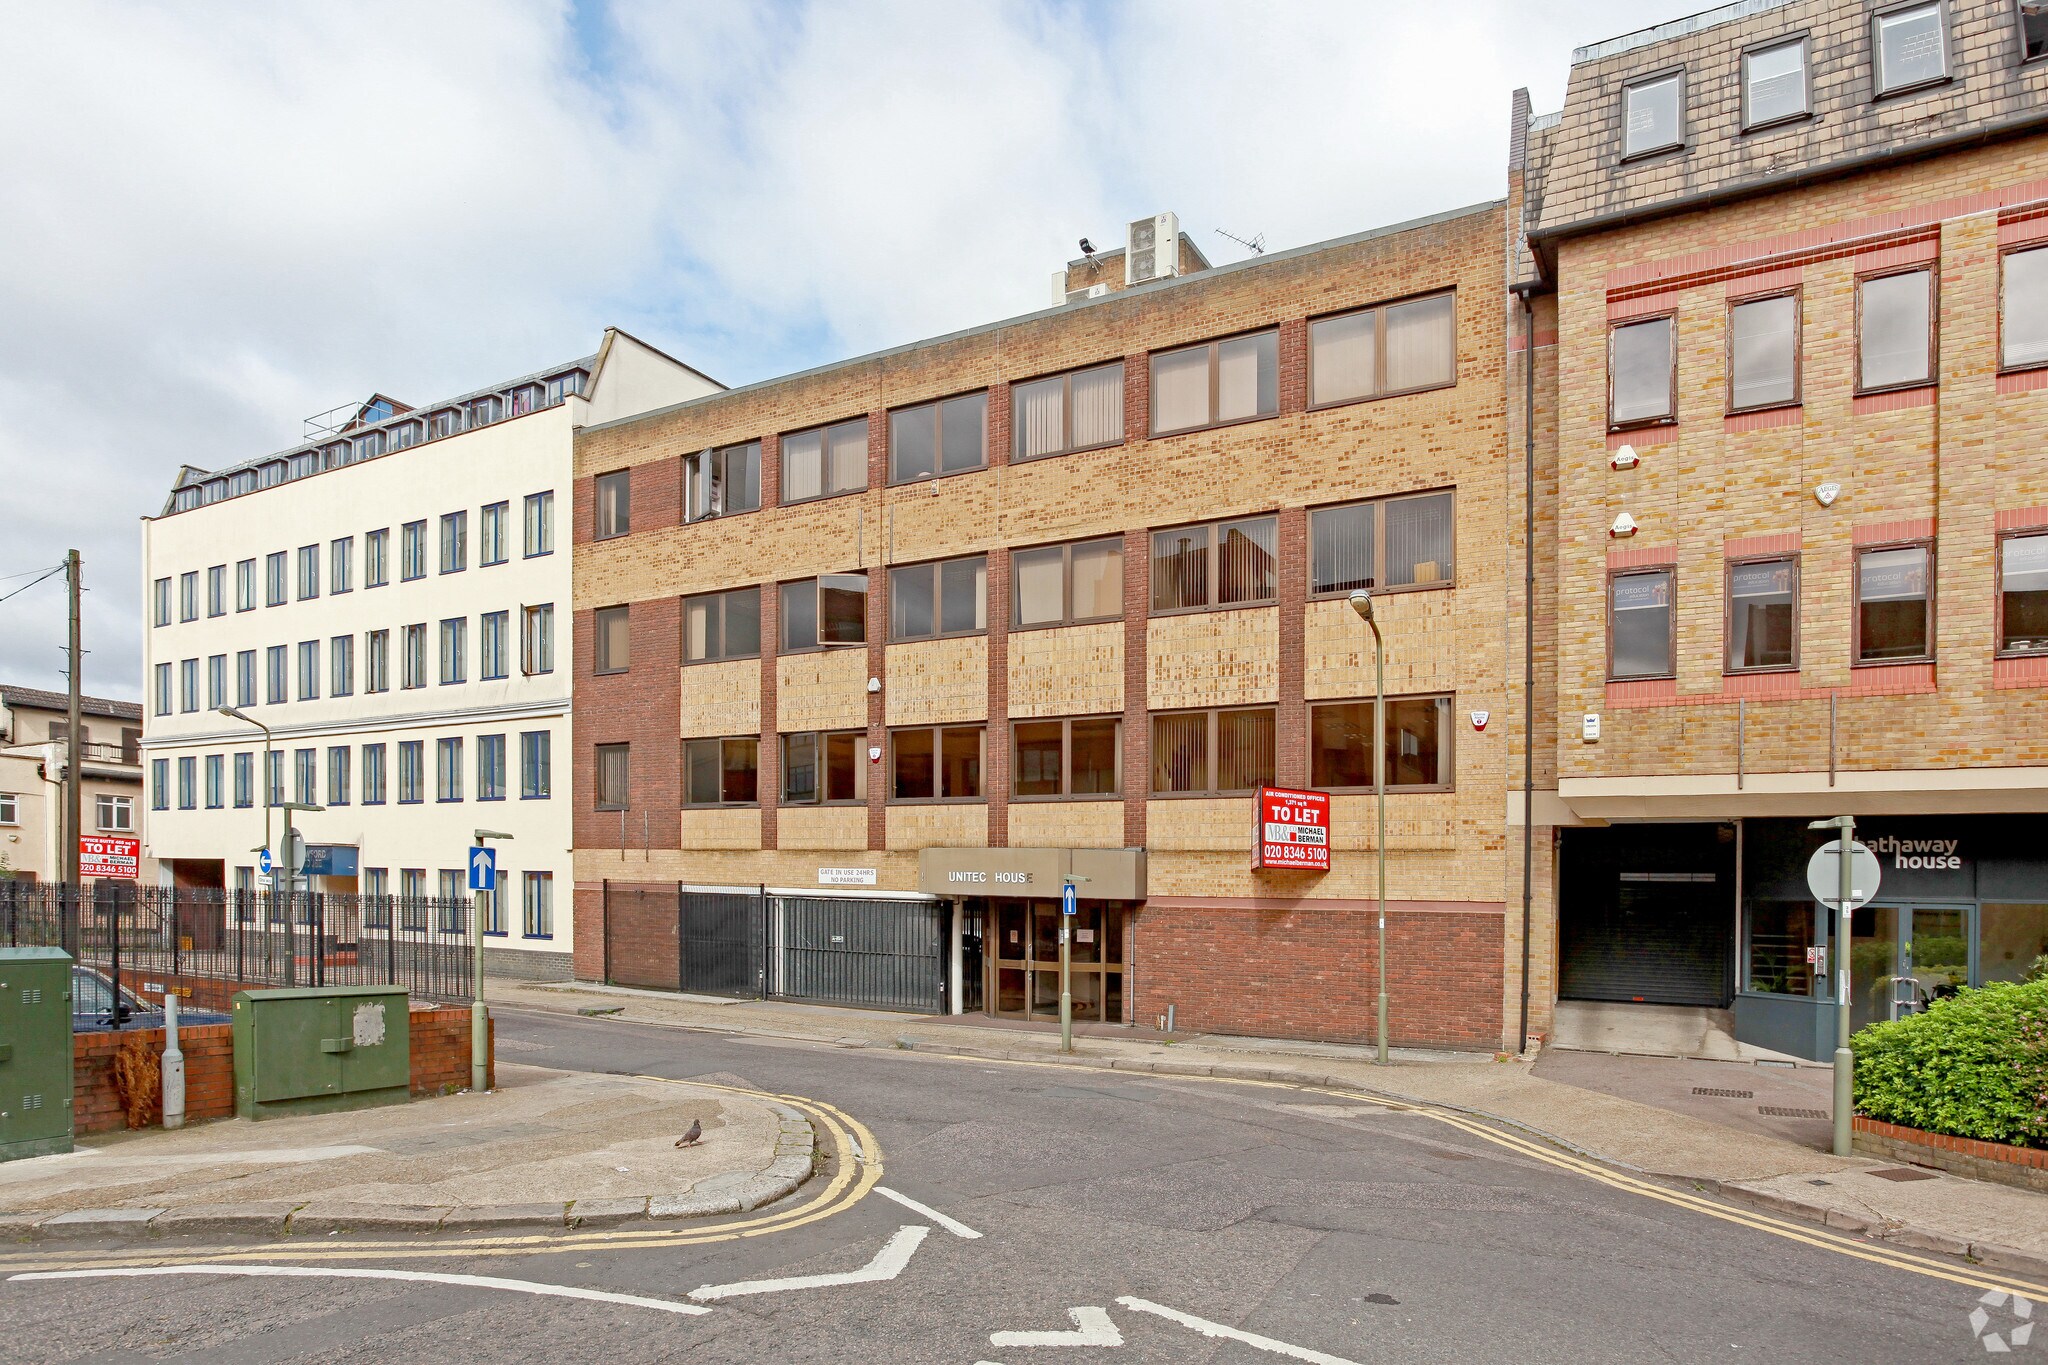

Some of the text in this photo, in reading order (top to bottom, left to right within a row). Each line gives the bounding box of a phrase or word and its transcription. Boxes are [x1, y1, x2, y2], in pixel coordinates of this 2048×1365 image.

[1733, 571, 1770, 583] protocol
[1861, 571, 1901, 585] protocol
[1615, 585, 1650, 597] protocol
[1275, 791, 1306, 800] CONDITIONED
[1271, 805, 1320, 824] TO LET
[1297, 826, 1324, 836] MICHAEL
[1298, 835, 1324, 844] BERMAN
[85, 843, 131, 855] TO LET
[1264, 844, 1328, 860] 020 8346 5100
[1895, 852, 1961, 869] house
[96, 865, 116, 873] 8346
[118, 866, 137, 874] 5100
[948, 871, 987, 883] UNITEC
